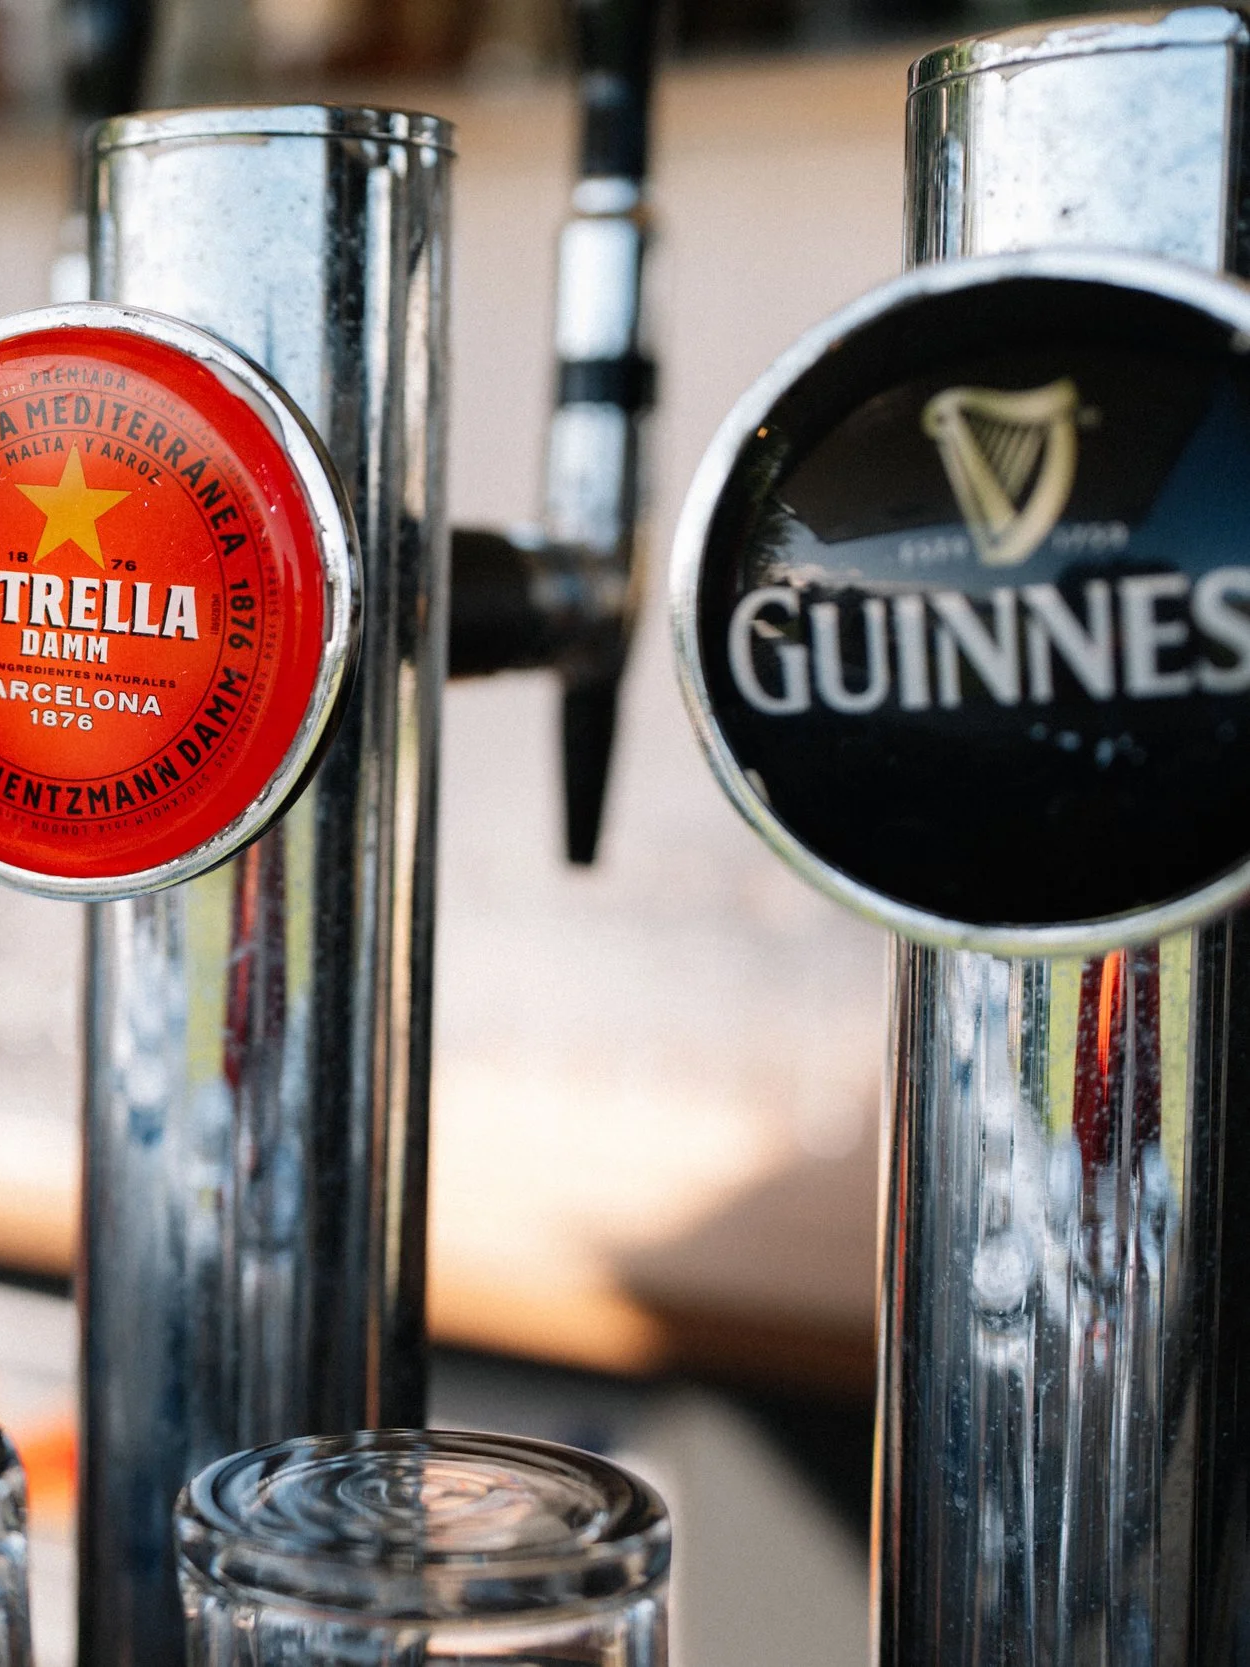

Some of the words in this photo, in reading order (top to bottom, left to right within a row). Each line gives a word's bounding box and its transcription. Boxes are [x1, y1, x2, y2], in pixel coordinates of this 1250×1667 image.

[29, 368, 127, 390] PREMIADA
[5, 436, 64, 467] MALTA
[85, 437, 94, 453] Y
[101, 443, 162, 485] ARROZ
[25, 397, 246, 556] MEDITERRÁNEA
[229, 578, 255, 651] 1876
[8, 551, 29, 563] 18
[111, 558, 138, 572] 76
[19, 628, 110, 664] DAMM
[94, 671, 177, 689] NATURALES
[29, 708, 95, 732] 1876
[178, 666, 249, 768] DAMM
[134, 772, 210, 826] STOCKHOLM
